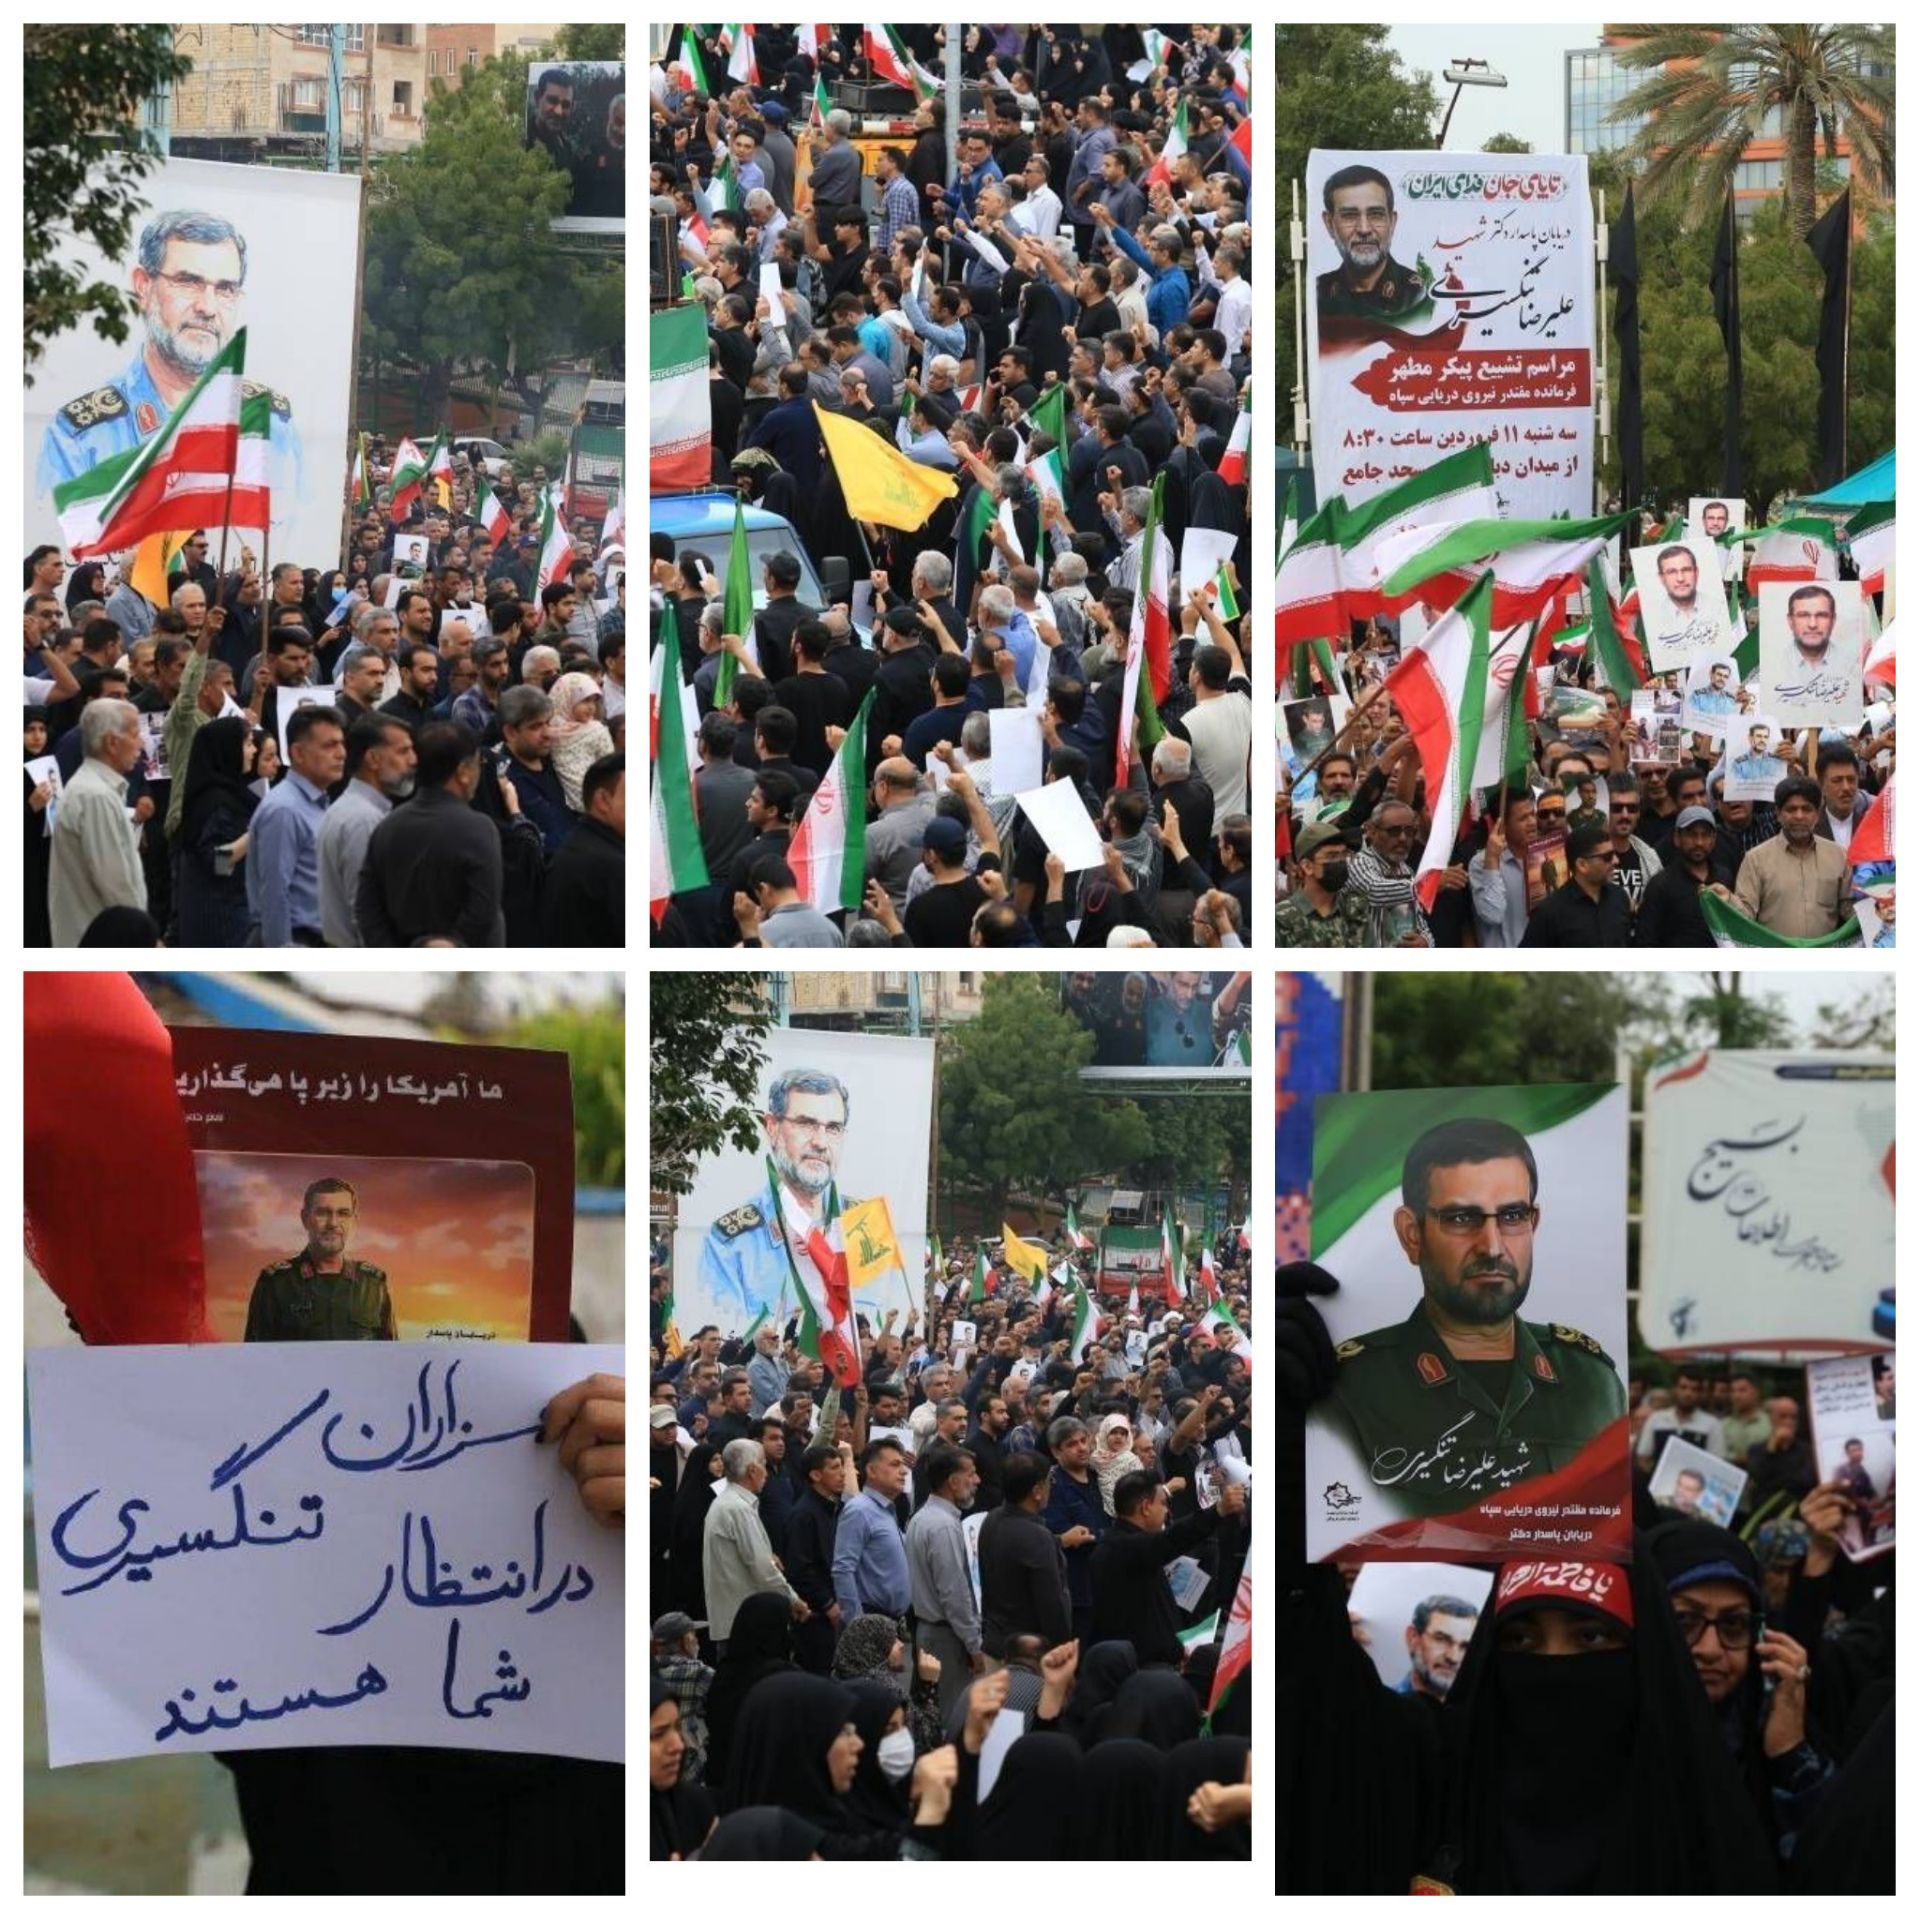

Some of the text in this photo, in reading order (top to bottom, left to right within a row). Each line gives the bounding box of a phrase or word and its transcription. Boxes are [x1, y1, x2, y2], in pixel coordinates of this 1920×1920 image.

[1408, 174, 1445, 199] ایران
[1446, 174, 1484, 199] فدای
[1483, 174, 1519, 200] جان
[1432, 208, 1571, 260] دریابان پاسدار دکتر شهید
[1430, 256, 1574, 338] علیرضا تنگسیری
[1388, 354, 1576, 383] مراسم تشییع پیکر مطهر
[1389, 382, 1577, 407] فرمانده مقتدر نیروی دریایی سپاه
[1343, 424, 1577, 449] سه شنبه ۱۱ فروردین ساعت ۸:۳۰
[1342, 461, 1384, 485] جامع
[1388, 462, 1424, 479] سجد
[1515, 456, 1560, 477] میدان
[1566, 455, 1578, 478] از
[289, 1070, 308, 1105] پا
[312, 1071, 353, 1101] زیر
[359, 1071, 379, 1102] را
[386, 1072, 469, 1105] آمریکا
[477, 1078, 503, 1100] ما
[1687, 1114, 1807, 1201] بسیج
[1371, 1410, 1532, 1491] شهید علیرضا تنگسیری
[51, 1360, 545, 1597] زاران تنگسیری
[1479, 1503, 1621, 1518] فرمانده مقتدر نیروی دریایی سپاه
[1508, 1528, 1593, 1544] دریابان پاسدار دکتر
[1588, 1572, 1613, 1602] یا
[154, 1618, 531, 1742] شما هستند
